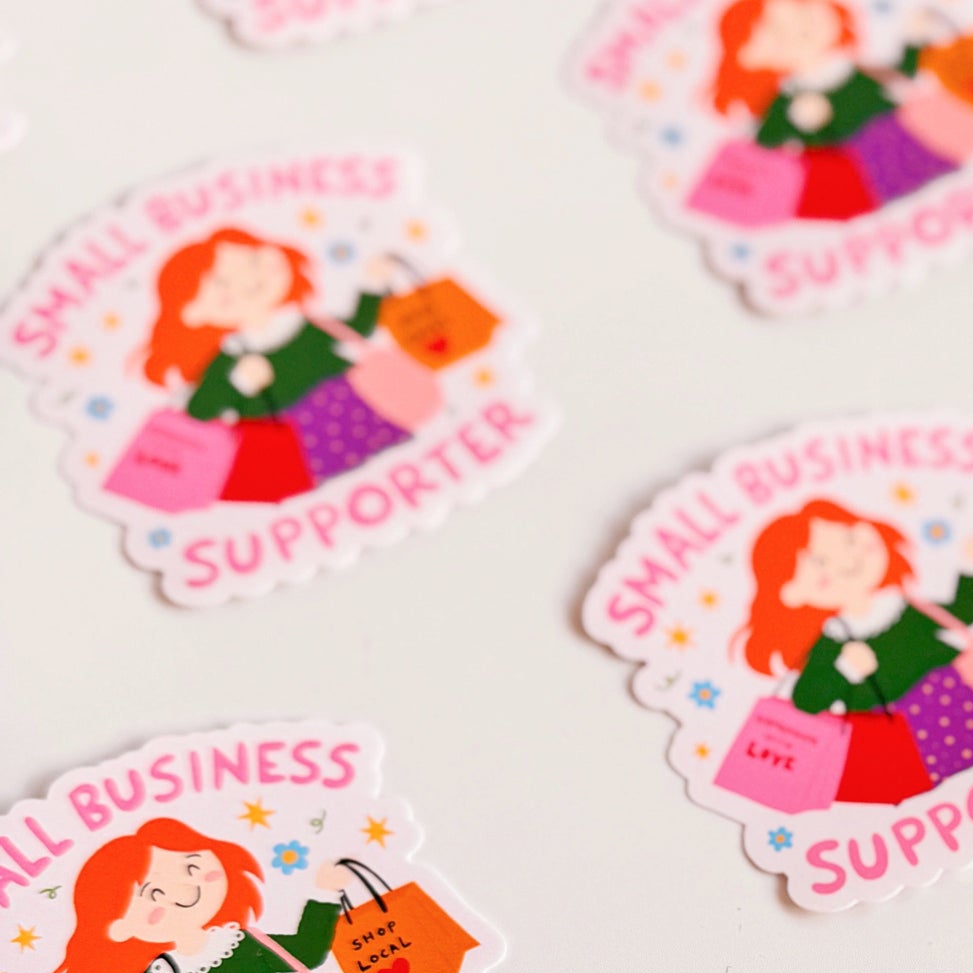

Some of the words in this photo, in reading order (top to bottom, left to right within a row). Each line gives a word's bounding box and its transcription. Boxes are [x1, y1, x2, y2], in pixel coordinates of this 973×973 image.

[182, 400, 533, 589] SUPPORTER
[605, 493, 742, 639] SMALL
[67, 739, 360, 832] BUSINESS
[351, 920, 396, 951] SHOP
[357, 936, 412, 972] LOCAL
